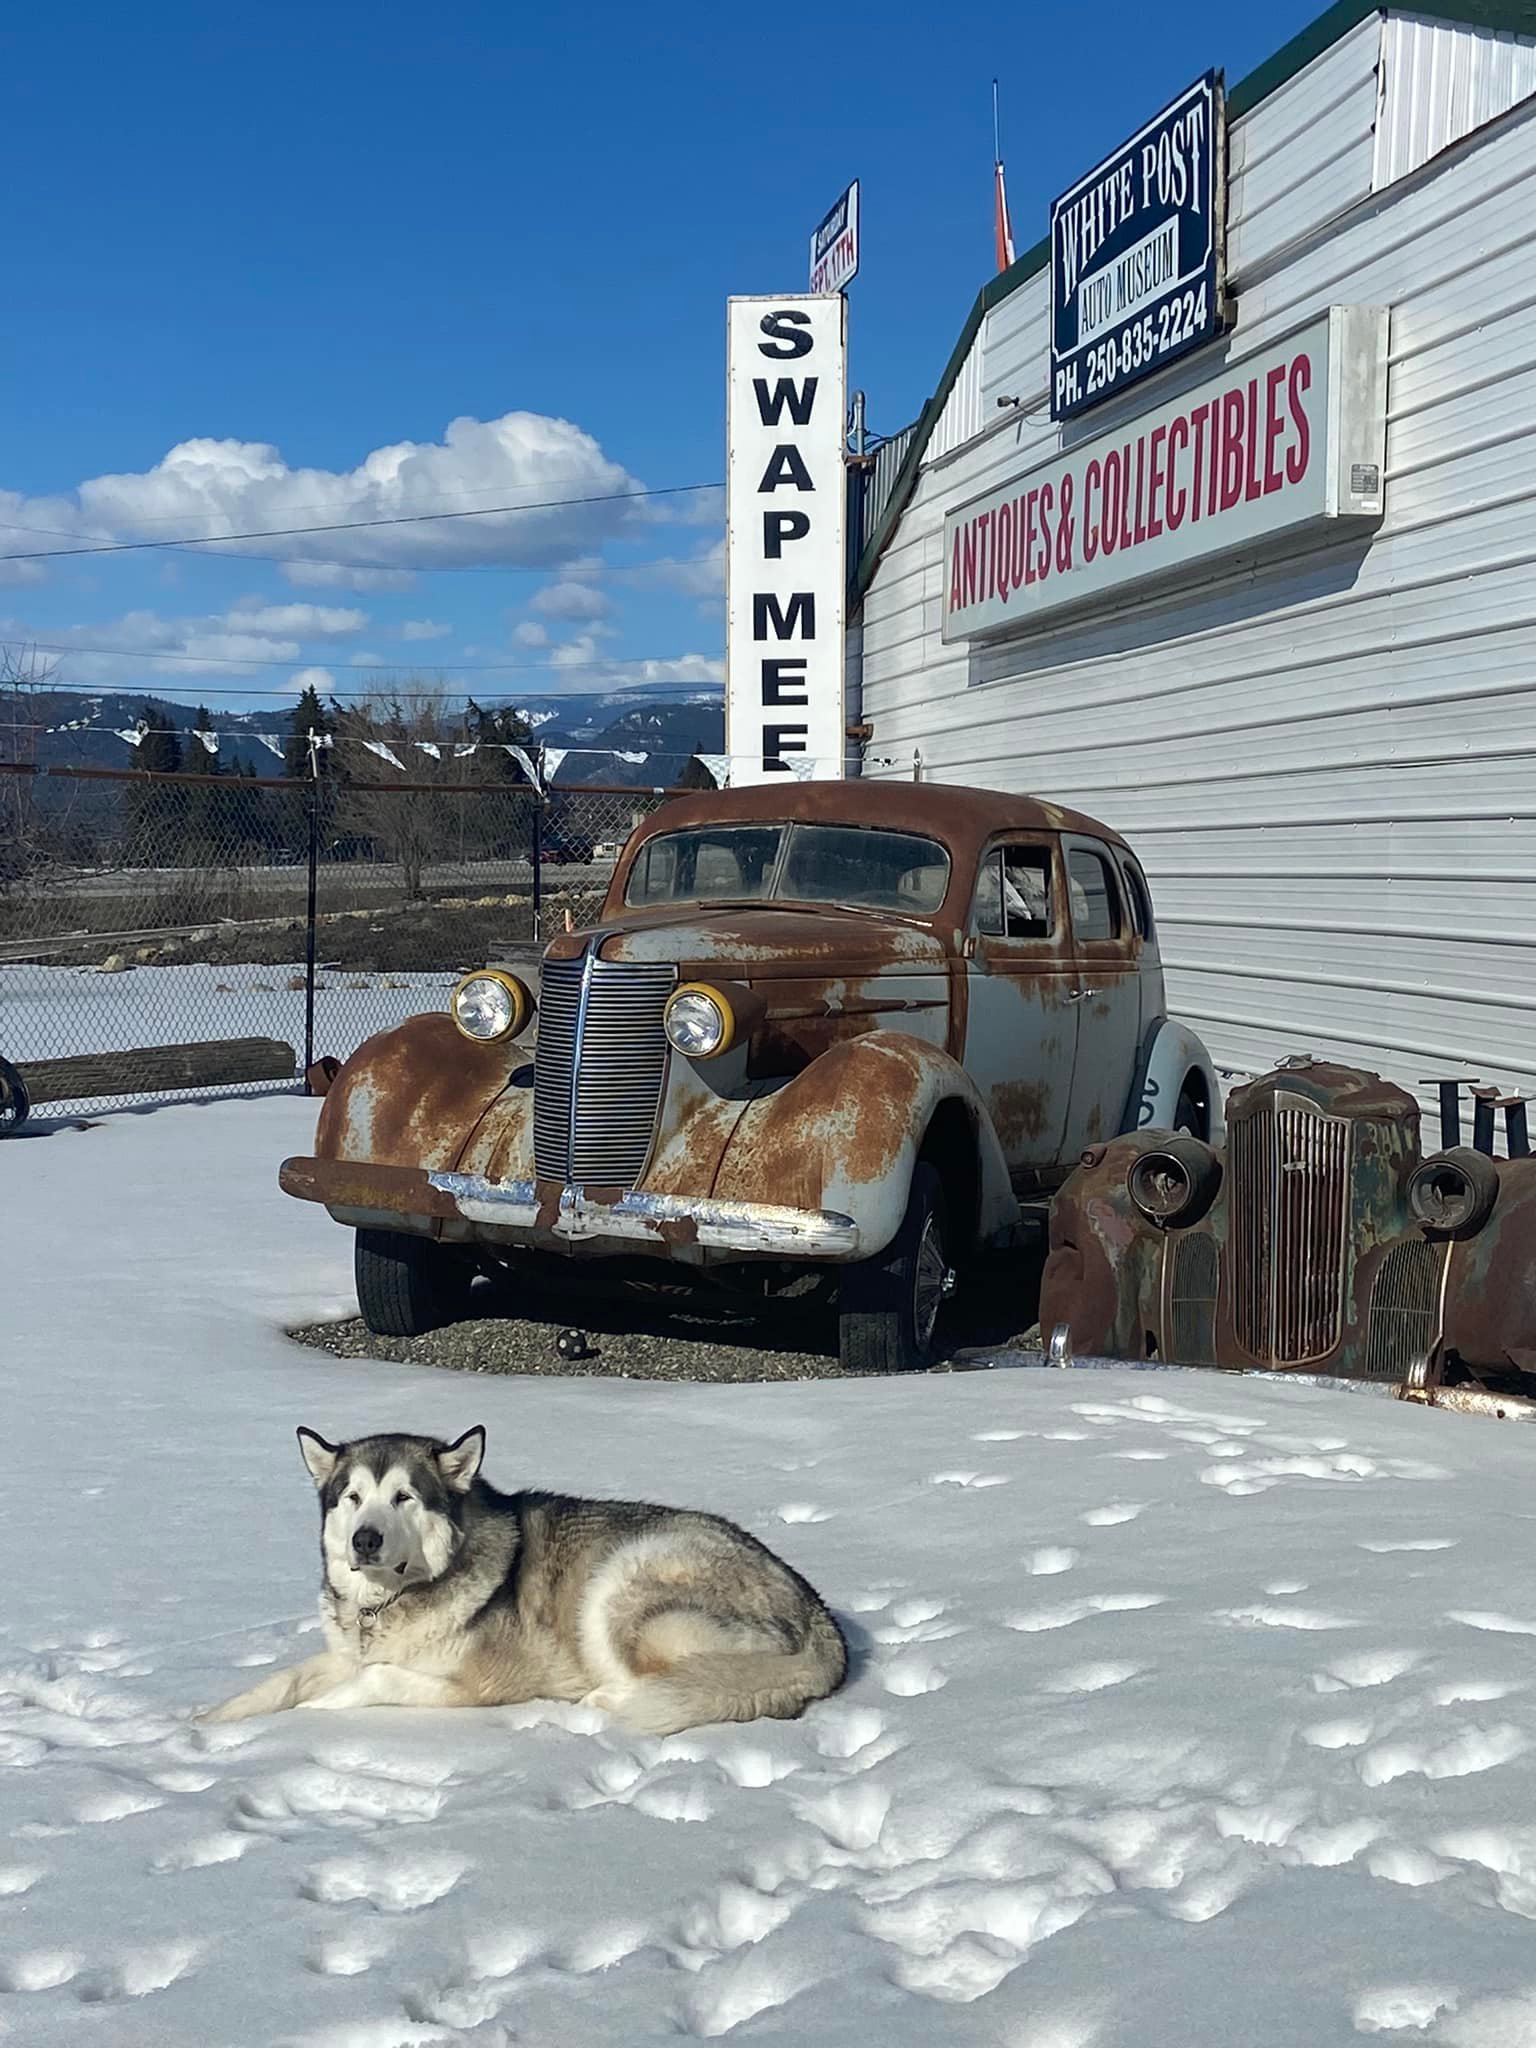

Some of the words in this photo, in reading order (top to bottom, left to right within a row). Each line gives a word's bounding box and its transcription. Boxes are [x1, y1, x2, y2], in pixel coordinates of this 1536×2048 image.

[1059, 158, 1135, 308] WHITE
[1142, 101, 1205, 215] POST
[1081, 273, 1113, 336] AUTO
[1116, 224, 1175, 314] MUSEUM
[752, 310, 819, 560] SWAP
[1055, 364, 1083, 413] PH.
[1086, 280, 1208, 396] 250-835-2224
[949, 481, 1054, 615] ANTIQUES
[1082, 353, 1312, 563] COLLECTIBLES
